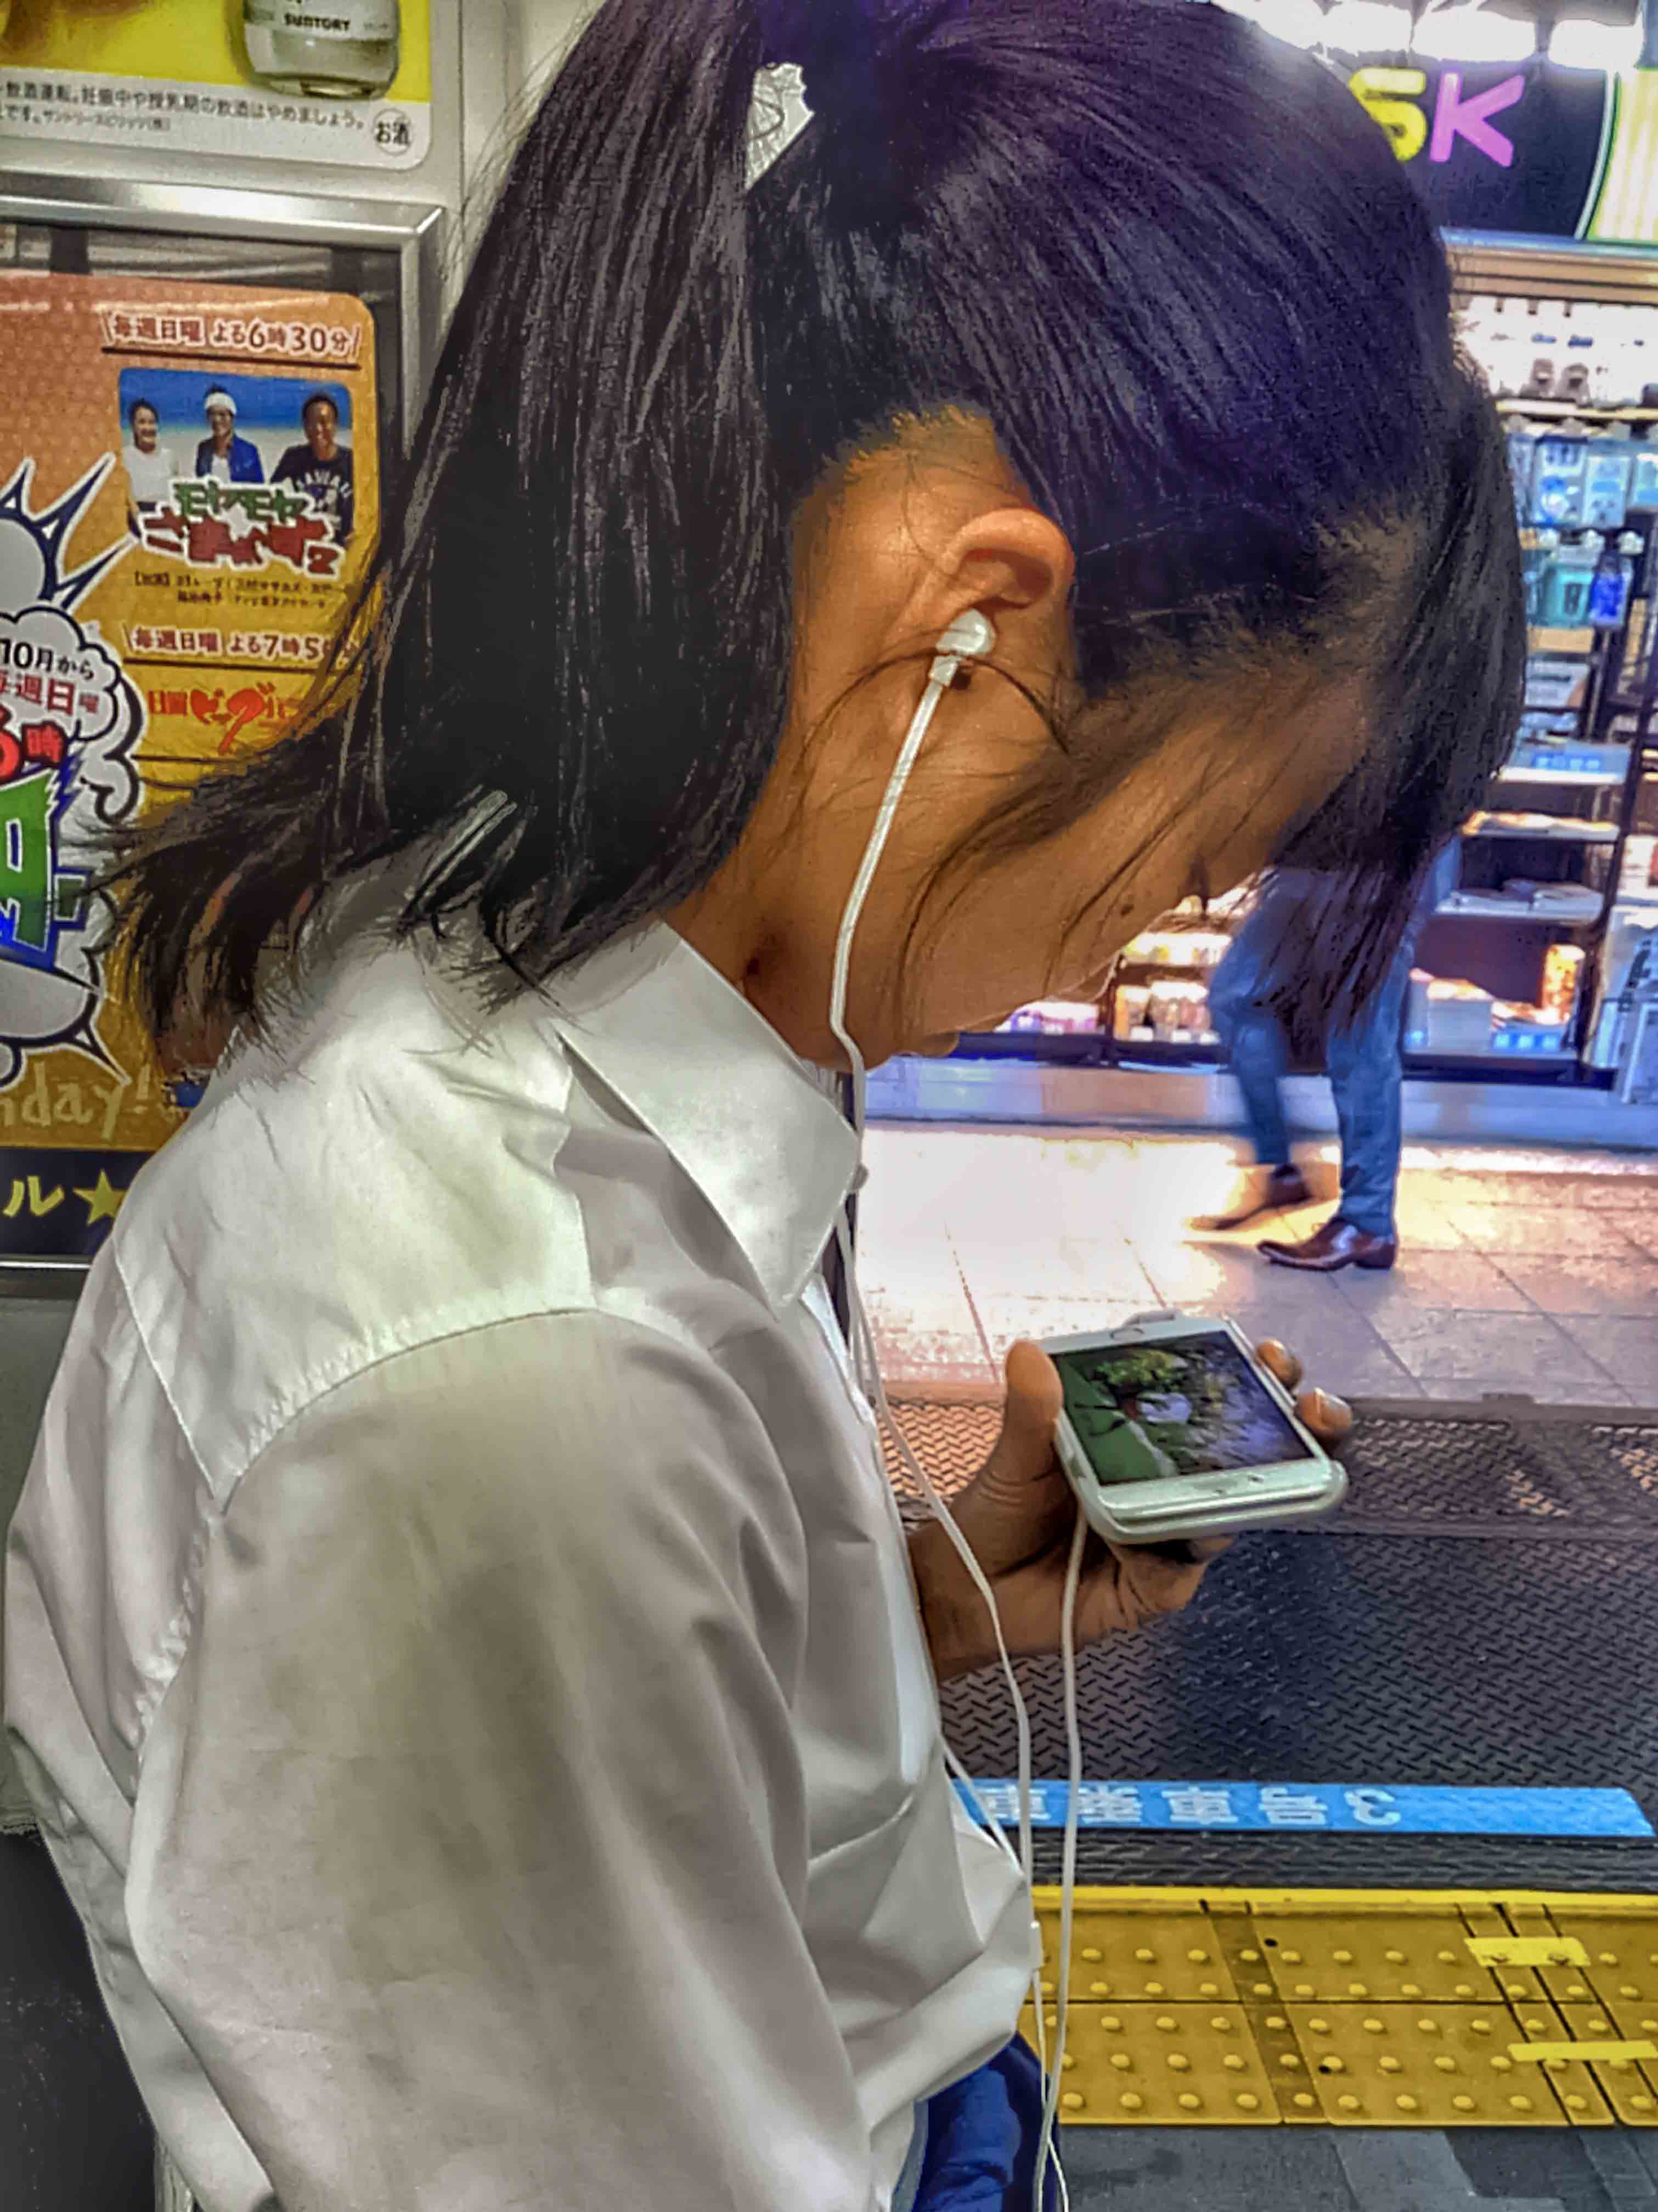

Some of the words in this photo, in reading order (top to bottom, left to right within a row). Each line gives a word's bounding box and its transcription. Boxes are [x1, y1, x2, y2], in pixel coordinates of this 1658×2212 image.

[284, 13, 350, 30] SUNTORY
[375, 121, 411, 145] お酒
[114, 313, 202, 344] 毎週日曜
[213, 318, 350, 353] よる6時30分
[134, 627, 220, 653] 毎週日曜
[0, 639, 95, 680] 10月から
